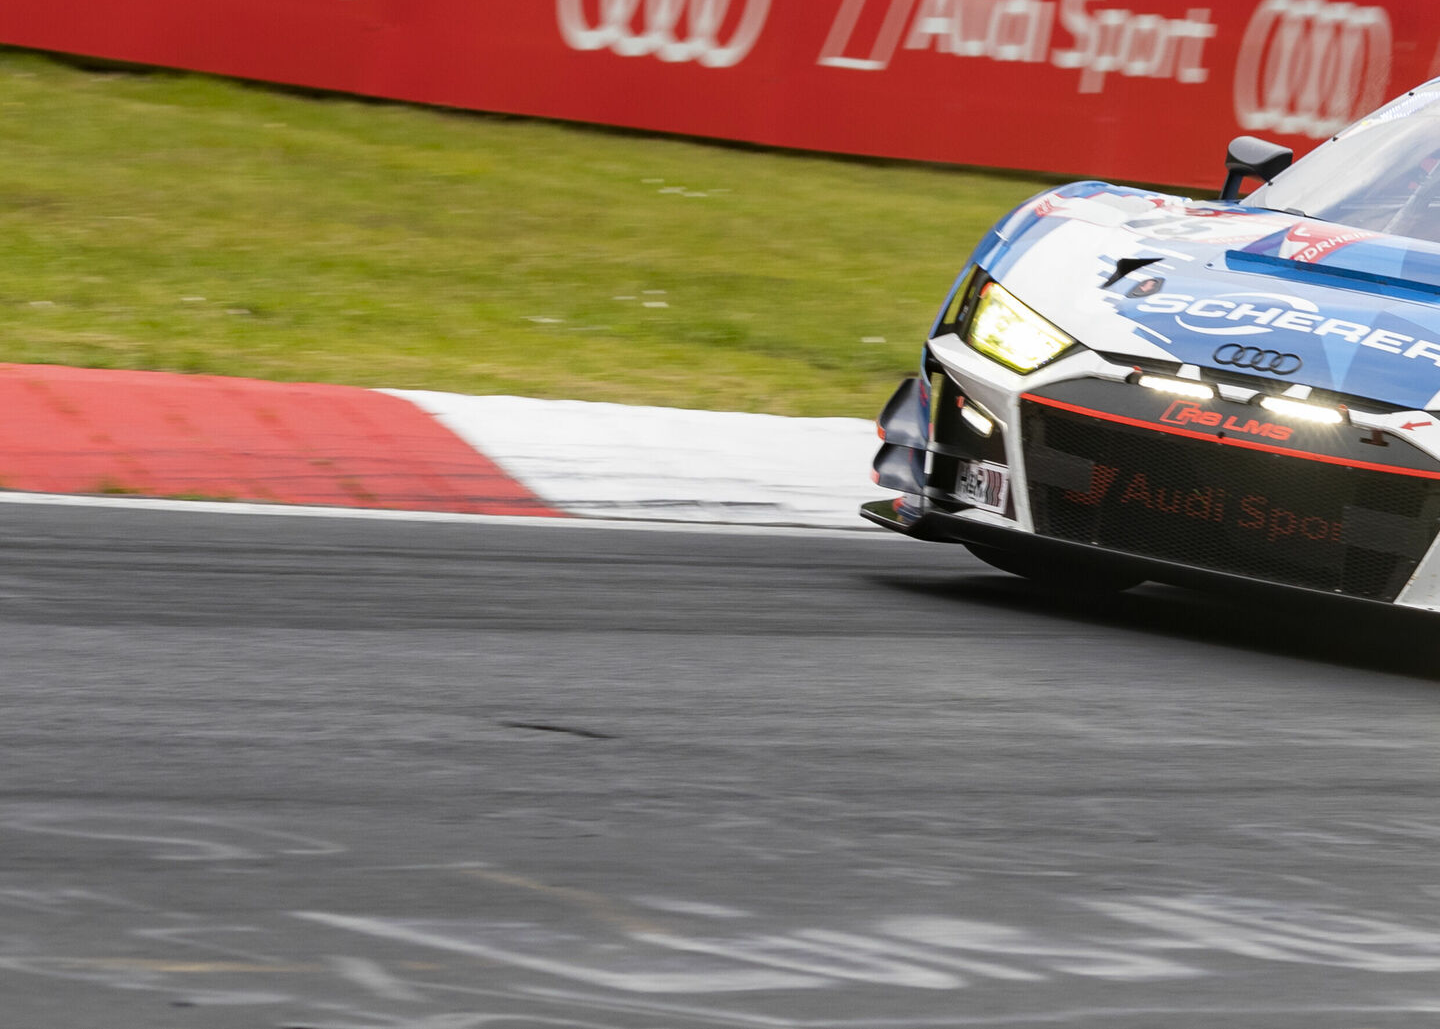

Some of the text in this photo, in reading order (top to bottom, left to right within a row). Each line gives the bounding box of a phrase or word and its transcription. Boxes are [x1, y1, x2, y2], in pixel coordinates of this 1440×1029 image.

[1222, 416, 1294, 440] LMS
[1121, 473, 1343, 542] Audi Spor
